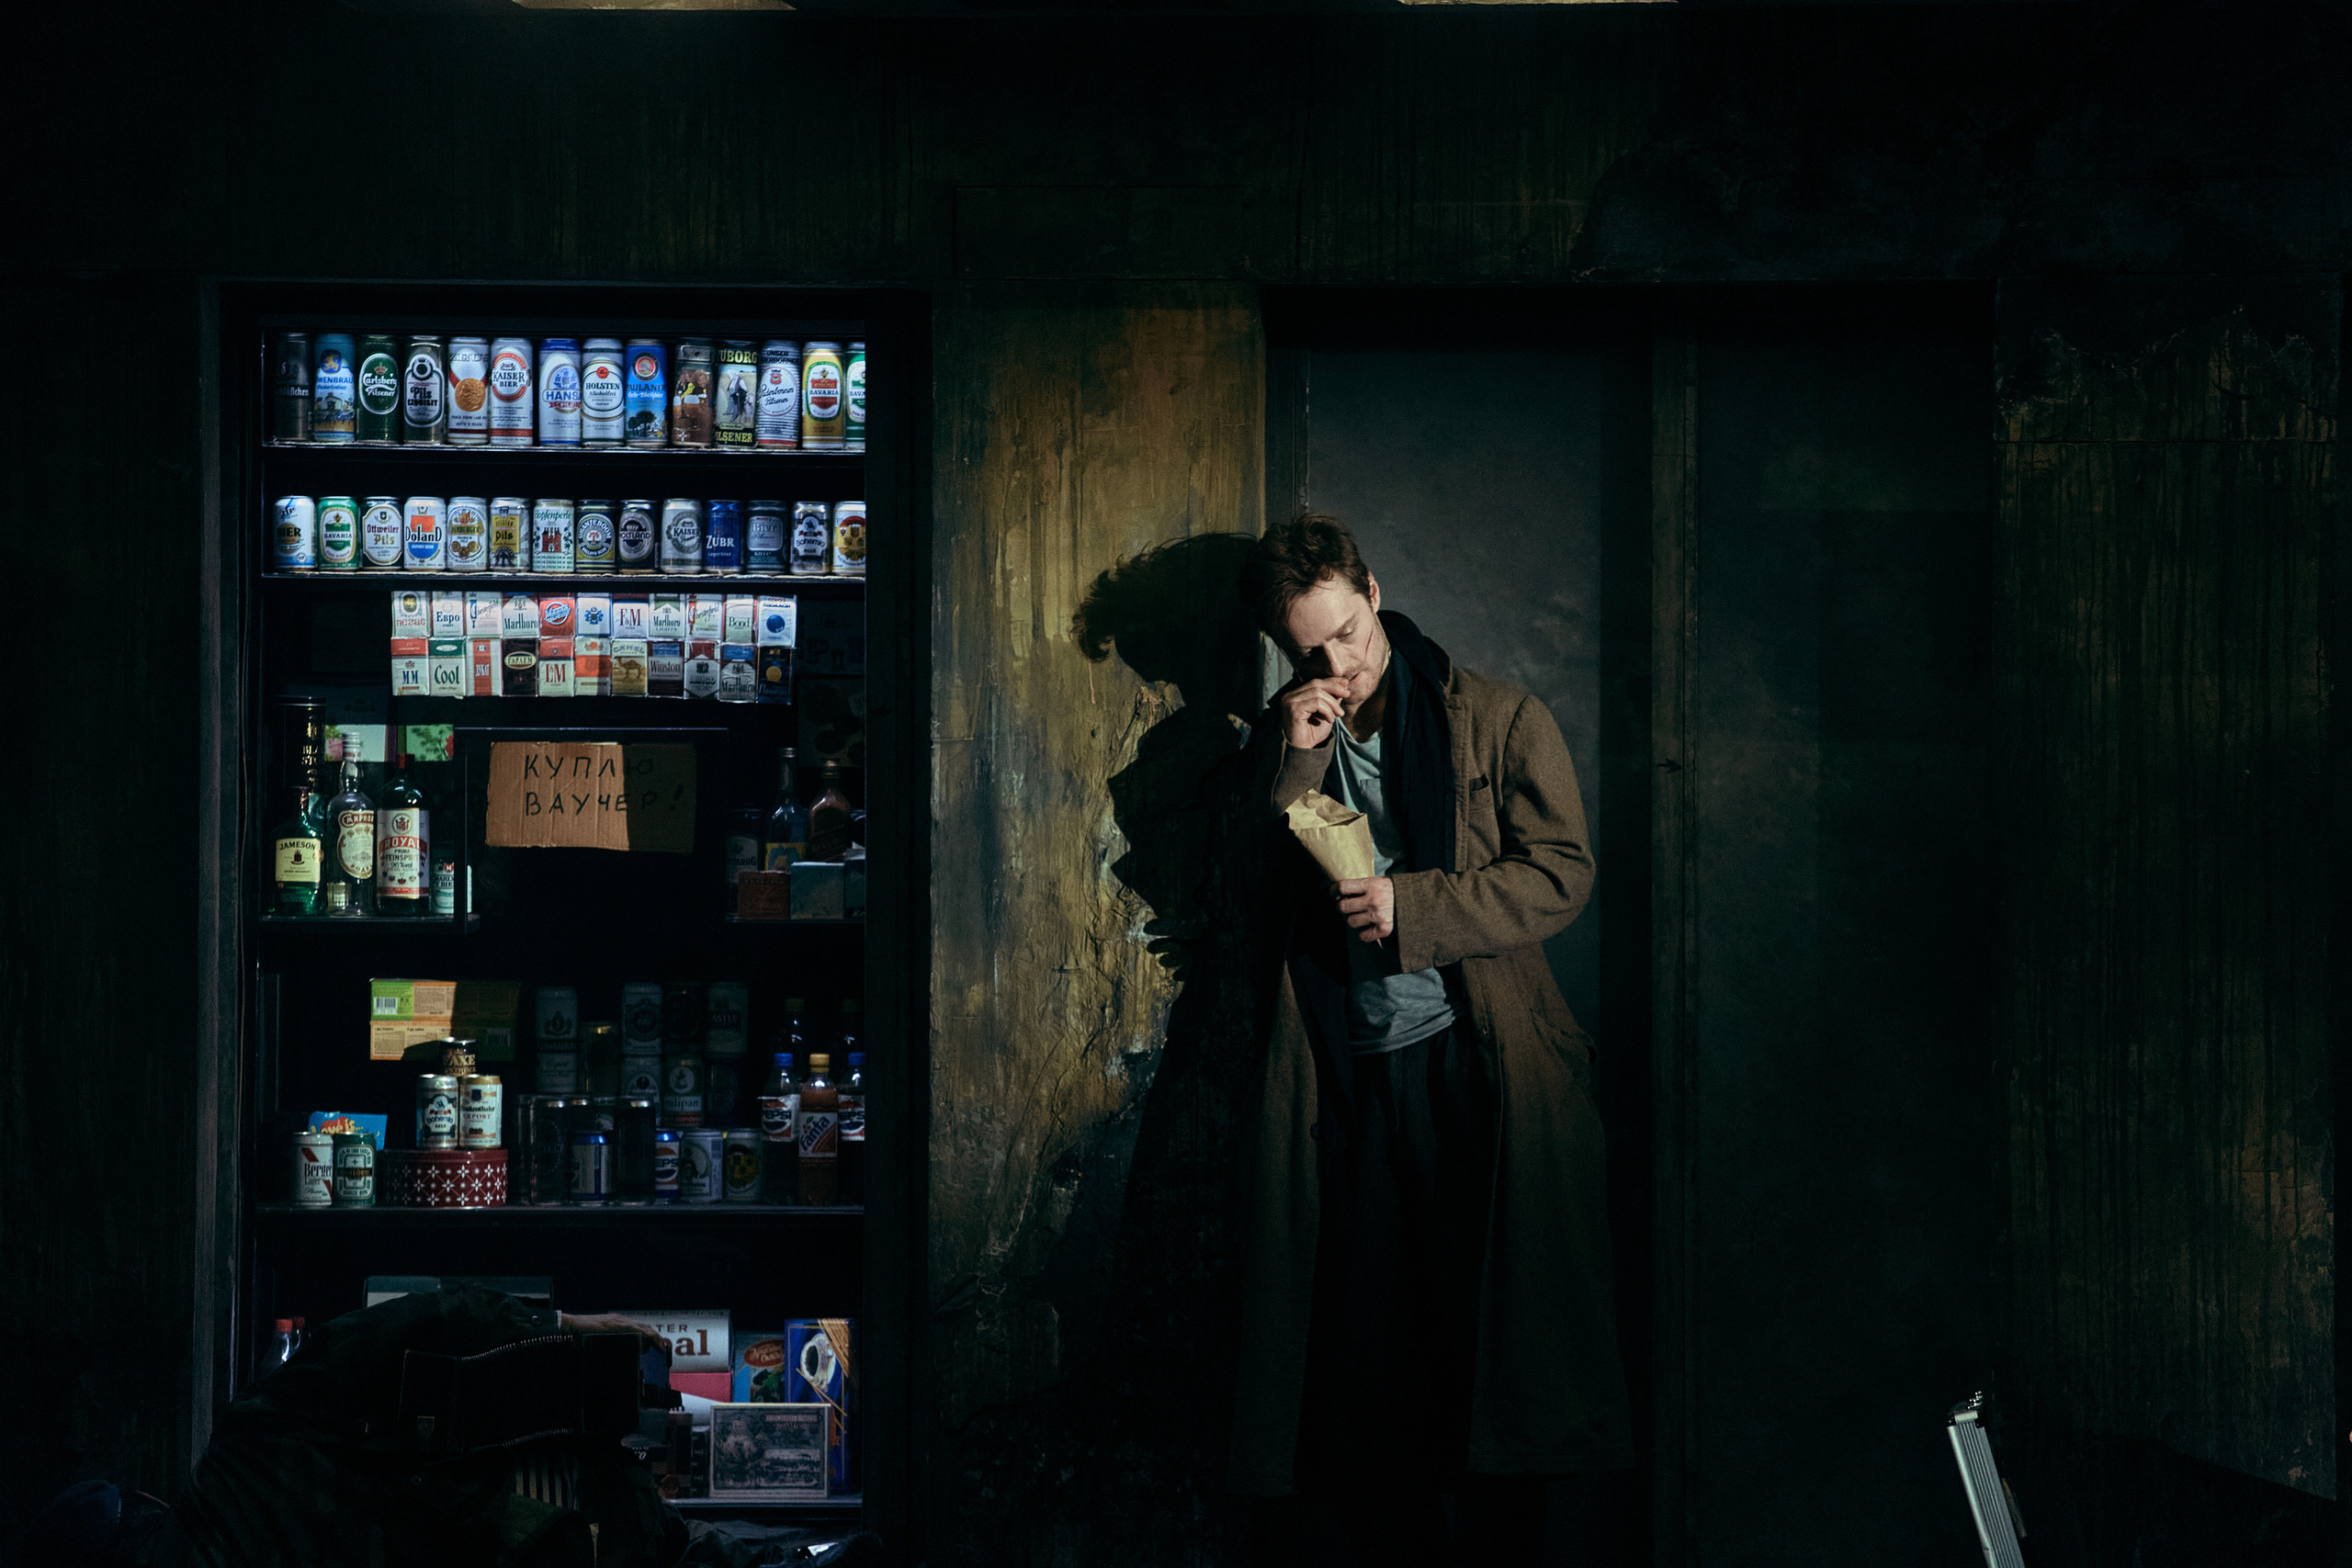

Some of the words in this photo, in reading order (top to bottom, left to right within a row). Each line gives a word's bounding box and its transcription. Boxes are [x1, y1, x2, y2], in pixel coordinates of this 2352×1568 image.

[363, 373, 397, 389] Carlsberg
[492, 371, 526, 382] KAISER
[585, 382, 620, 390] HOLSTEN
[368, 388, 396, 397] Pilsener
[410, 386, 432, 399] Pils
[715, 431, 753, 443] ILSENER
[276, 527, 302, 537] BIER
[367, 524, 399, 534] Ottweiler
[578, 519, 613, 539] ORANJEBOOM
[373, 534, 395, 546] Pils
[495, 531, 514, 542] Pils
[706, 534, 735, 549] ZUBR
[436, 611, 460, 624] Евро
[504, 614, 538, 629] Marlboro
[653, 615, 681, 627] Marlboro
[729, 616, 750, 627] Bond
[613, 645, 645, 654] CAMEL
[650, 660, 680, 673] Winston
[434, 664, 460, 684] Cool
[545, 663, 566, 683] L&M
[721, 677, 756, 693] Marlboro
[525, 753, 653, 780] КУПЛЮ
[526, 783, 684, 817] ВАУЧЕР!
[279, 840, 316, 851] JAMESON
[384, 837, 422, 850] ROYAL
[762, 1110, 792, 1120] PEPSI
[838, 1111, 865, 1121] EPS
[655, 1158, 680, 1168] EPS
[655, 1324, 688, 1333] TER
